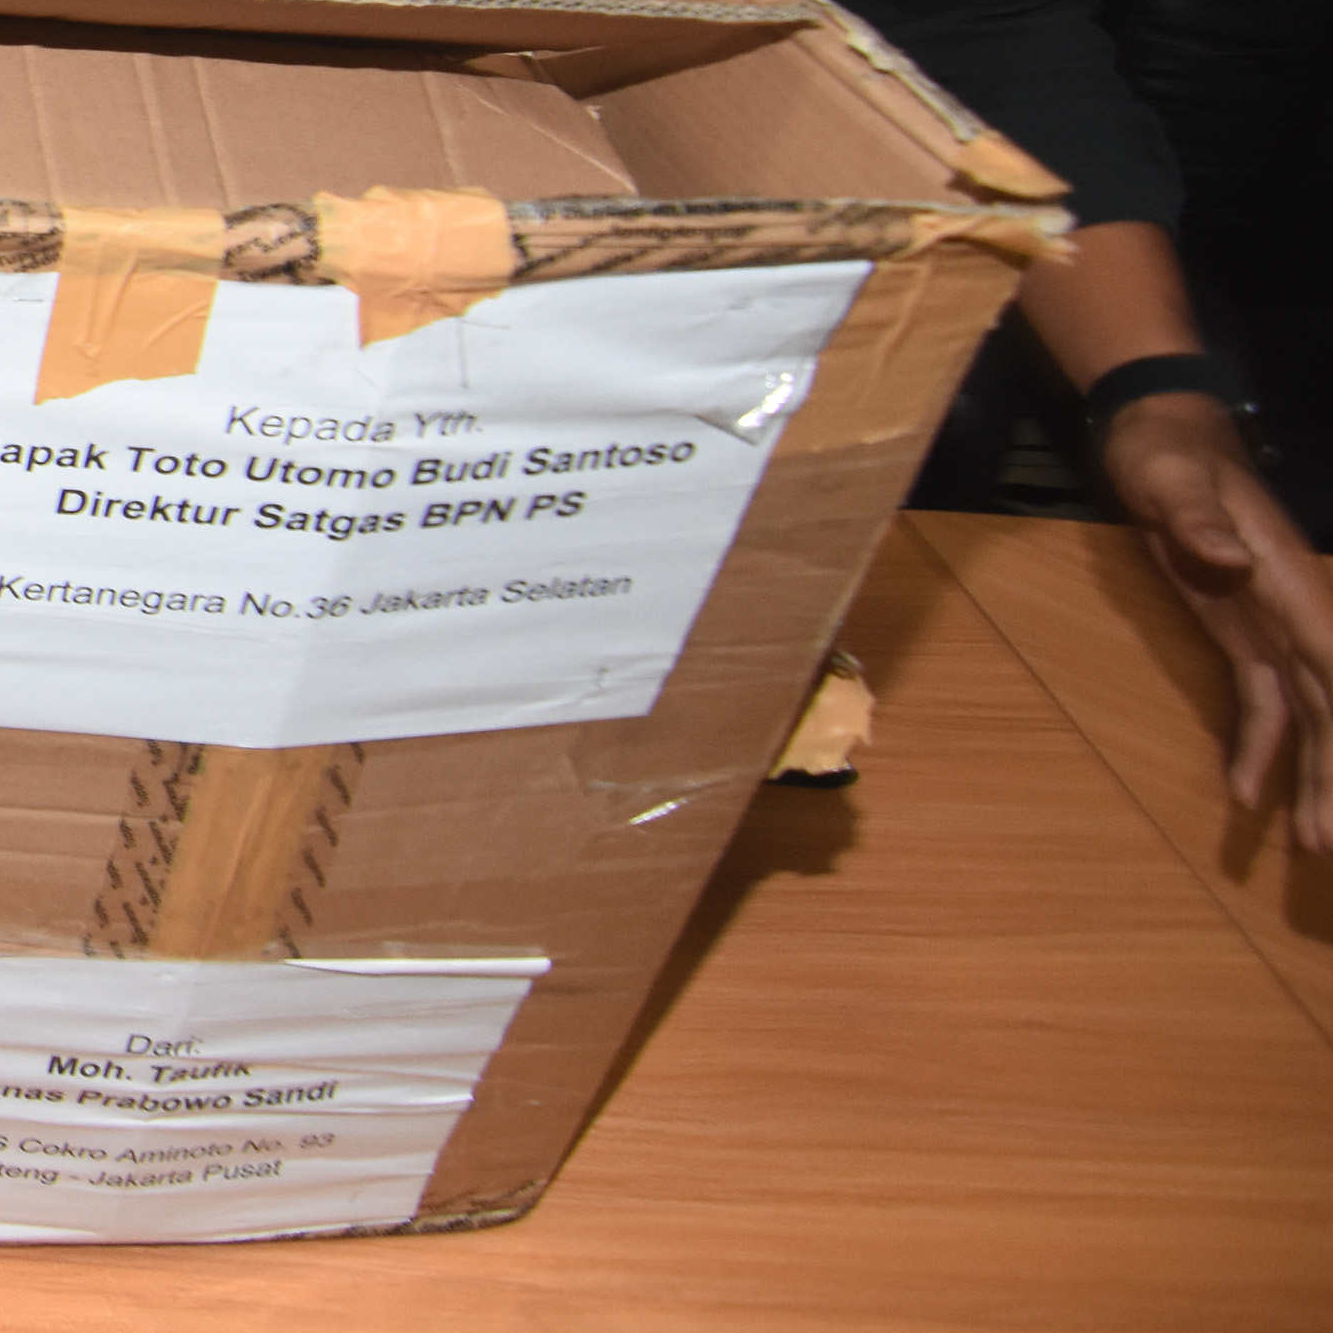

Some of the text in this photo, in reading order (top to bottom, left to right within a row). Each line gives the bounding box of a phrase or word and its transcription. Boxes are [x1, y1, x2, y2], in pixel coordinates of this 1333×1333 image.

[224, 403, 484, 446] Kepada Yth.
[127, 445, 229, 481] Toto
[243, 453, 396, 491] Utomo
[410, 450, 512, 488] Budi
[522, 434, 697, 479] Santoso
[55, 486, 588, 543] Direktur Satgas BPN PS
[238, 589, 351, 622] No.36
[358, 583, 490, 618] Jakarta
[498, 571, 634, 606] Selatan
[124, 1032, 205, 1058] Dari:
[46, 1054, 253, 1085] Moh. Taufik
[76, 1088, 232, 1115] Prabowo
[240, 1079, 341, 1108] Sandi
[17, 1136, 108, 1162] Cokro
[113, 1141, 235, 1165] Aminoto
[240, 1137, 285, 1155] No.
[297, 1132, 336, 1150] 93
[86, 1165, 194, 1190] Jakarta
[201, 1156, 284, 1184] Pusat
